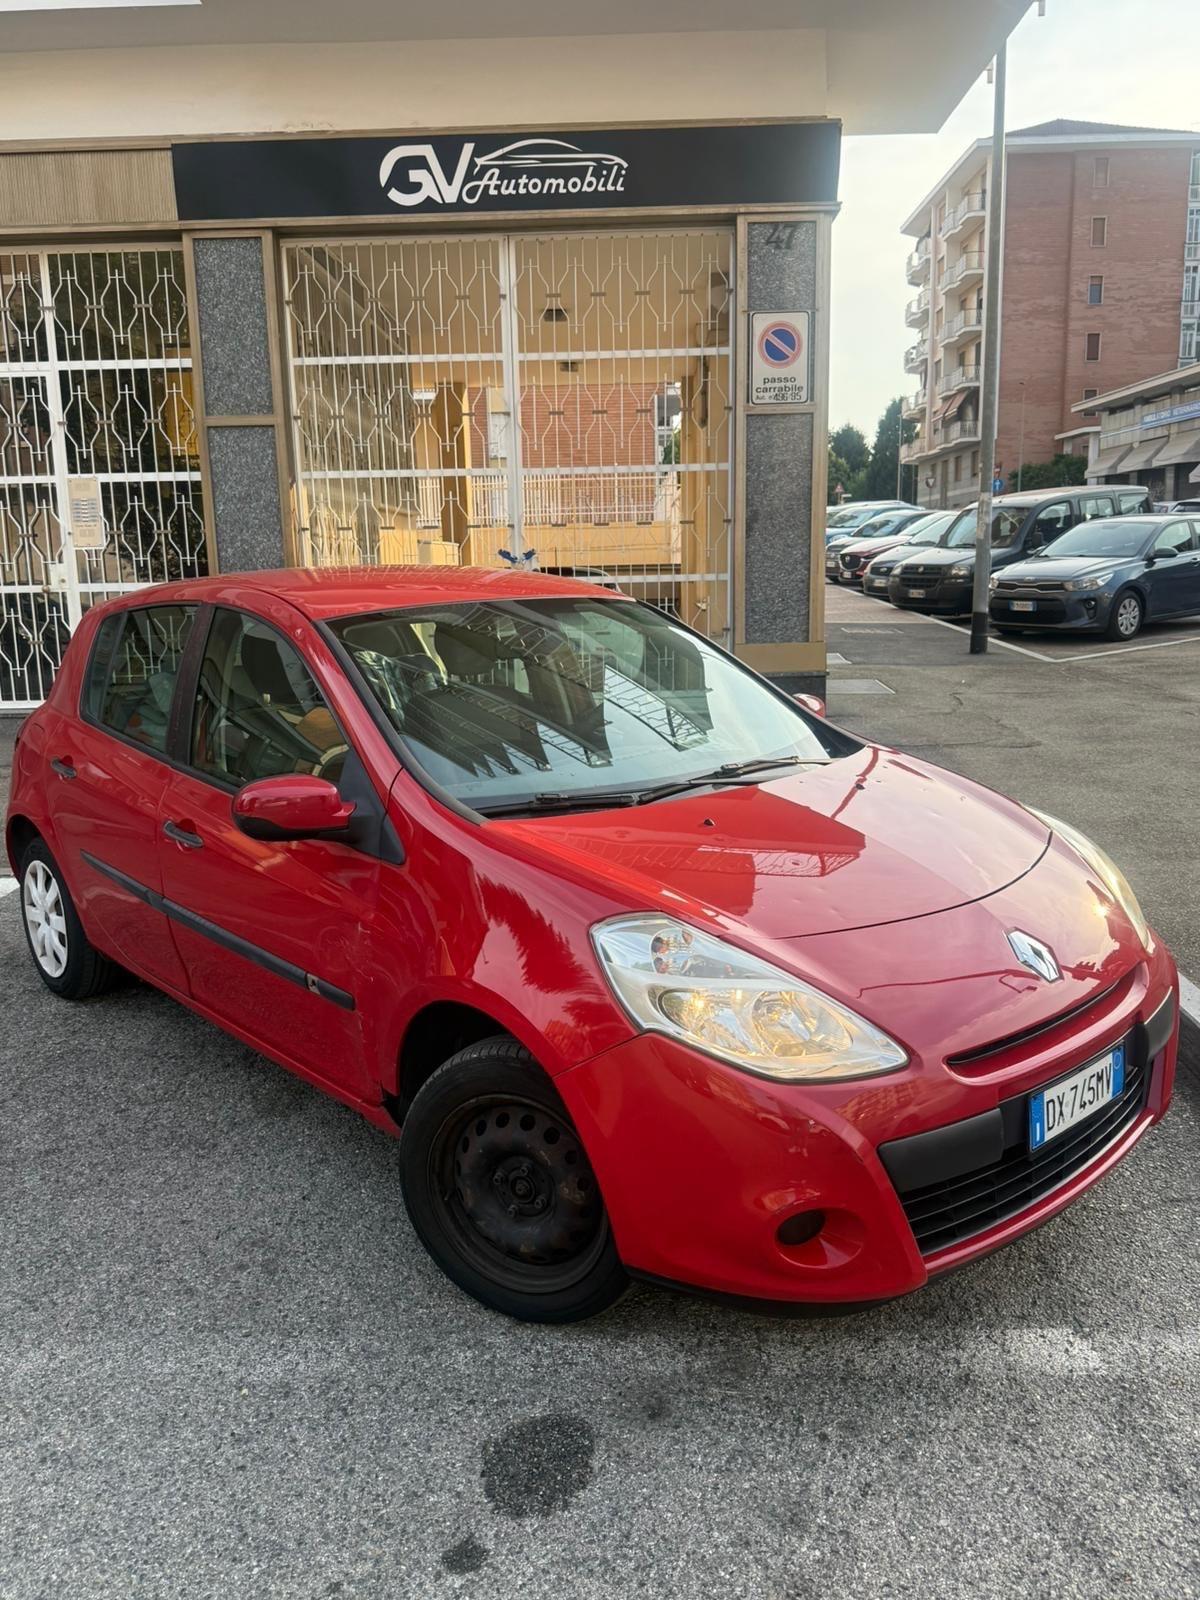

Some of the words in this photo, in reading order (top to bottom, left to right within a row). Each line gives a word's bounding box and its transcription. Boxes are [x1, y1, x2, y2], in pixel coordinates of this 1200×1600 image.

[379, 142, 475, 206] GV
[462, 164, 626, 204] Automobili
[766, 223, 796, 249] 47
[755, 384, 804, 393] carrabile
[763, 376, 796, 385] passo
